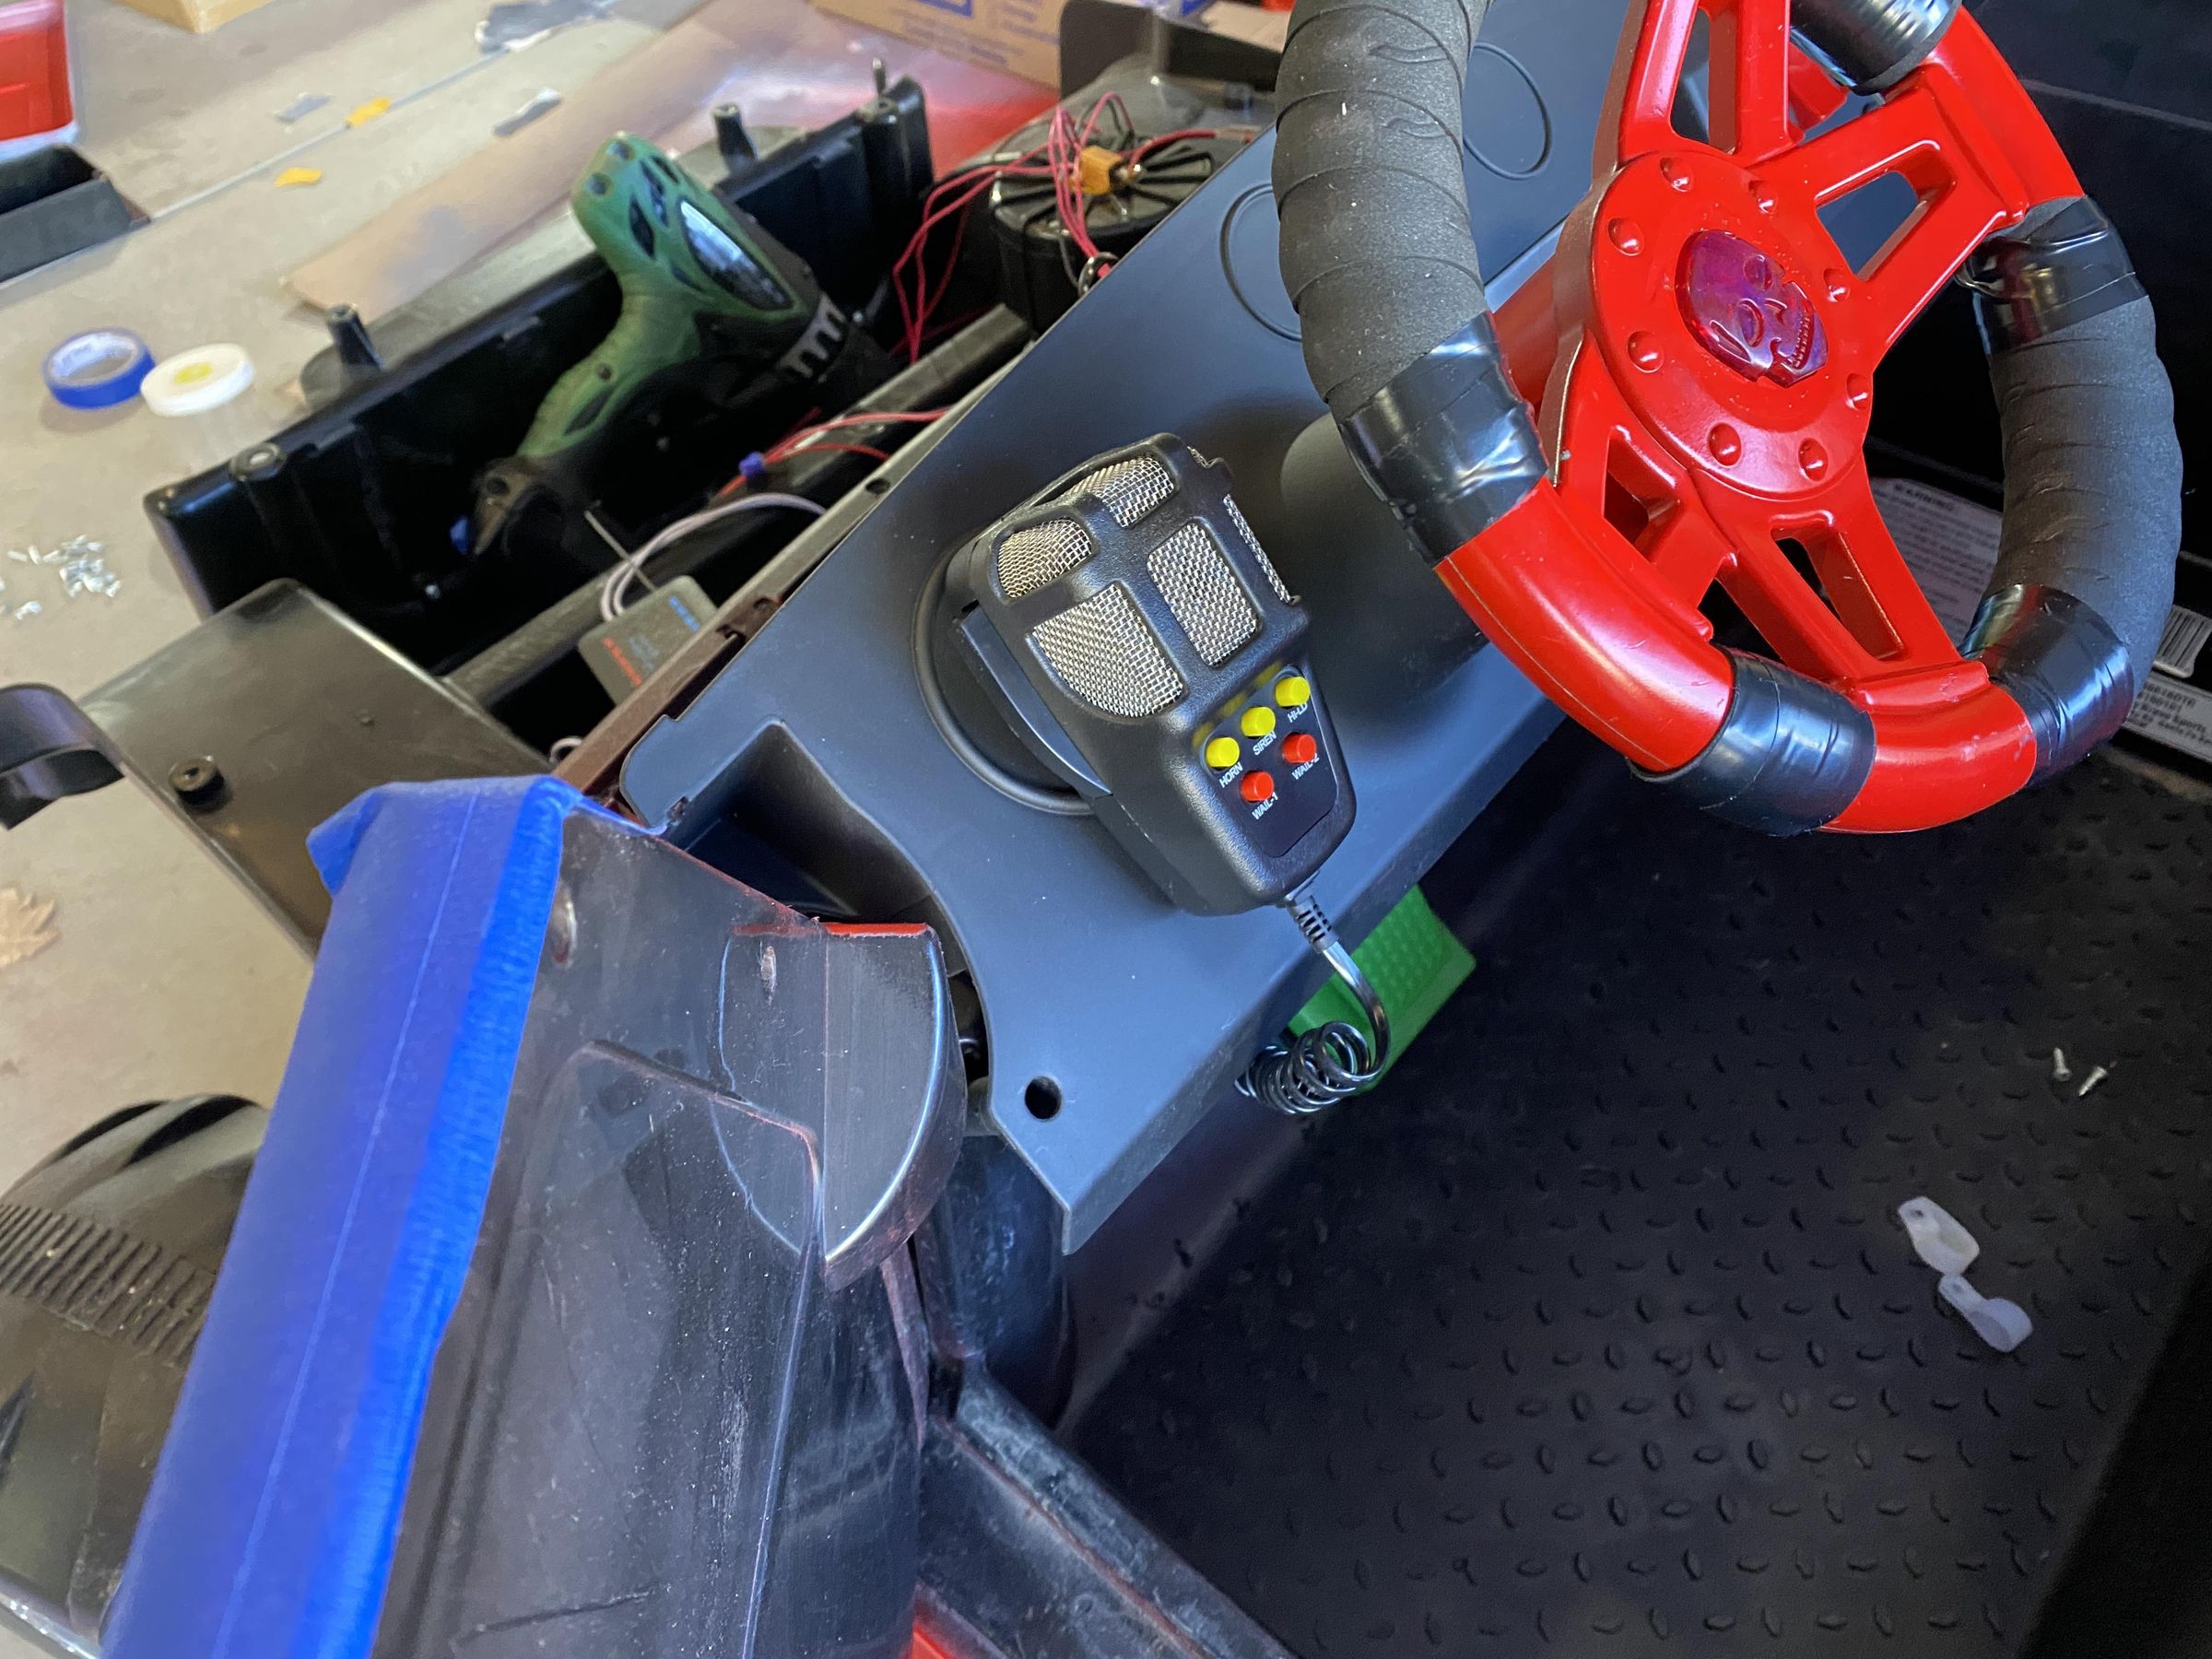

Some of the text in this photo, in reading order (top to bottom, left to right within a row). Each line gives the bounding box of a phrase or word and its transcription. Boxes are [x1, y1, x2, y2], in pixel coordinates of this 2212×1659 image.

[1253, 731, 1277, 756] SIREN
[1218, 762, 1243, 788] HORN
[1291, 753, 1320, 781] WAIL-2
[1252, 792, 1278, 820] WAIL-1
